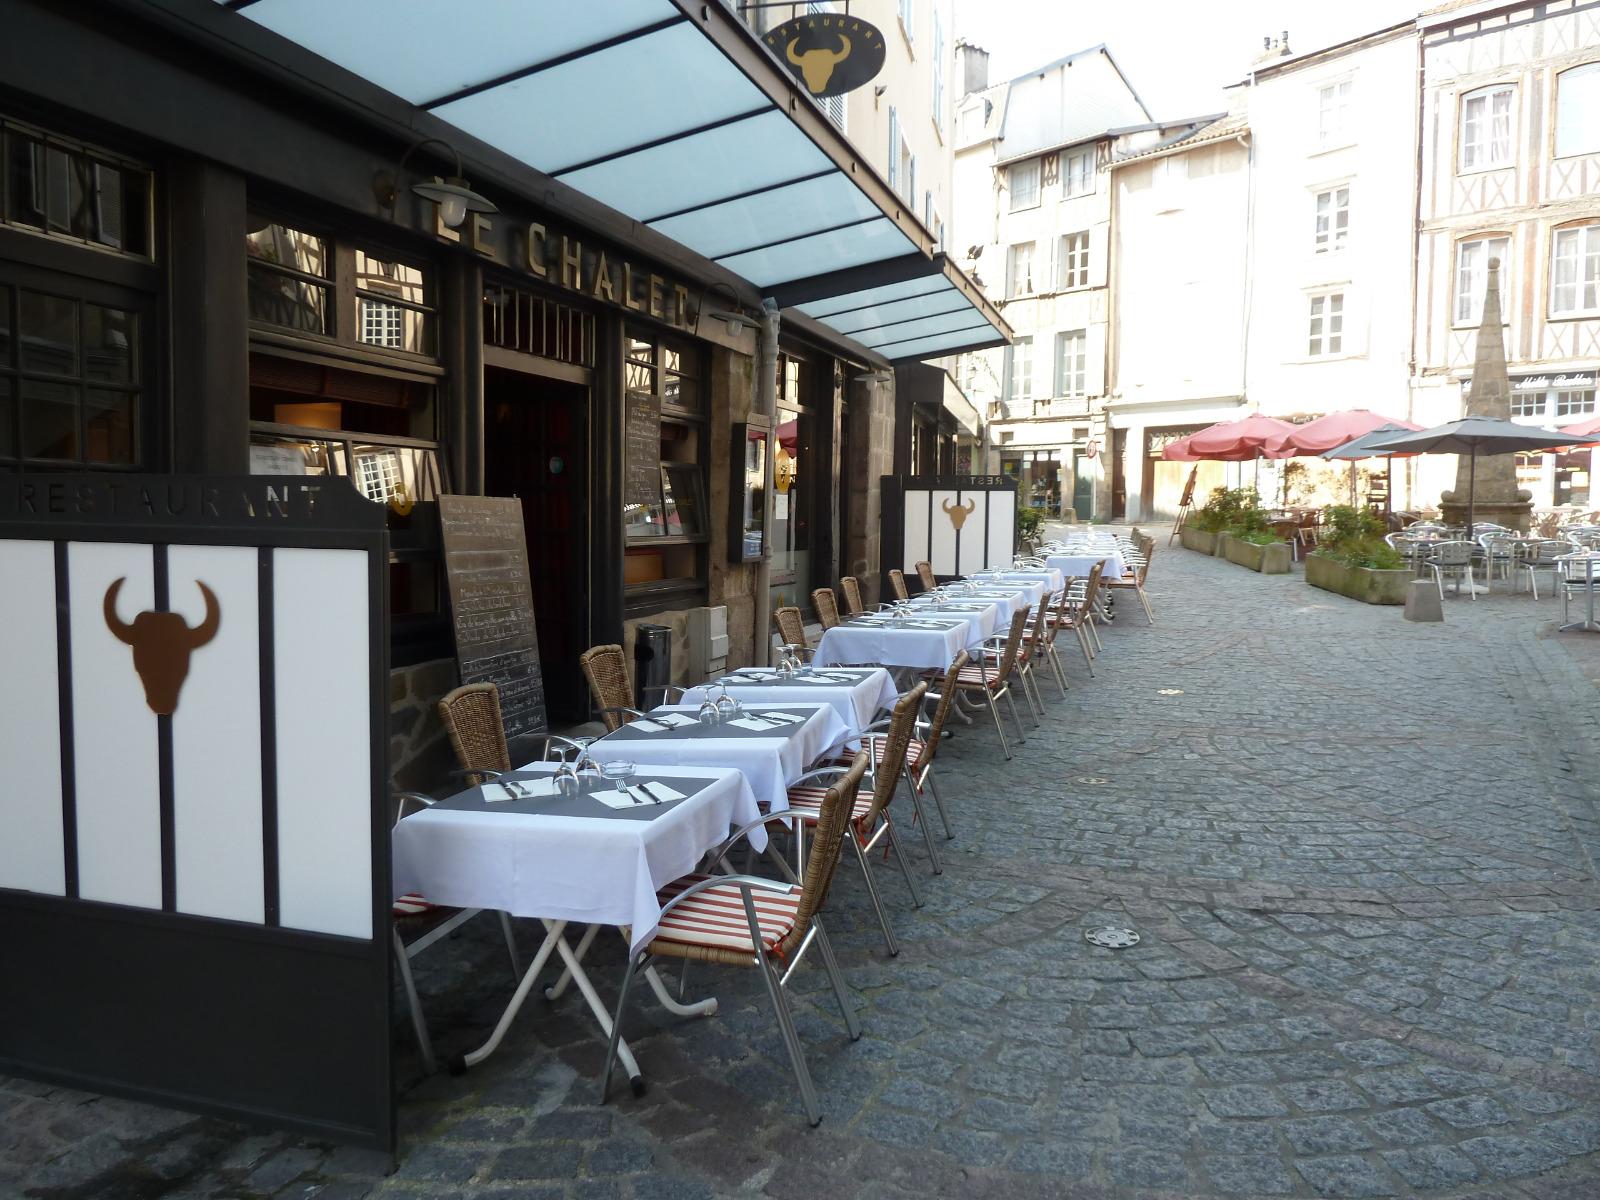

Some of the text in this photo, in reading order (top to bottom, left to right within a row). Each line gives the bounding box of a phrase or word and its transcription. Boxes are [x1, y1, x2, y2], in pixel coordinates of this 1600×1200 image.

[767, 17, 882, 49] ESTAURANT
[527, 222, 688, 326] CHALET
[18, 483, 321, 518] RESTAURANT
